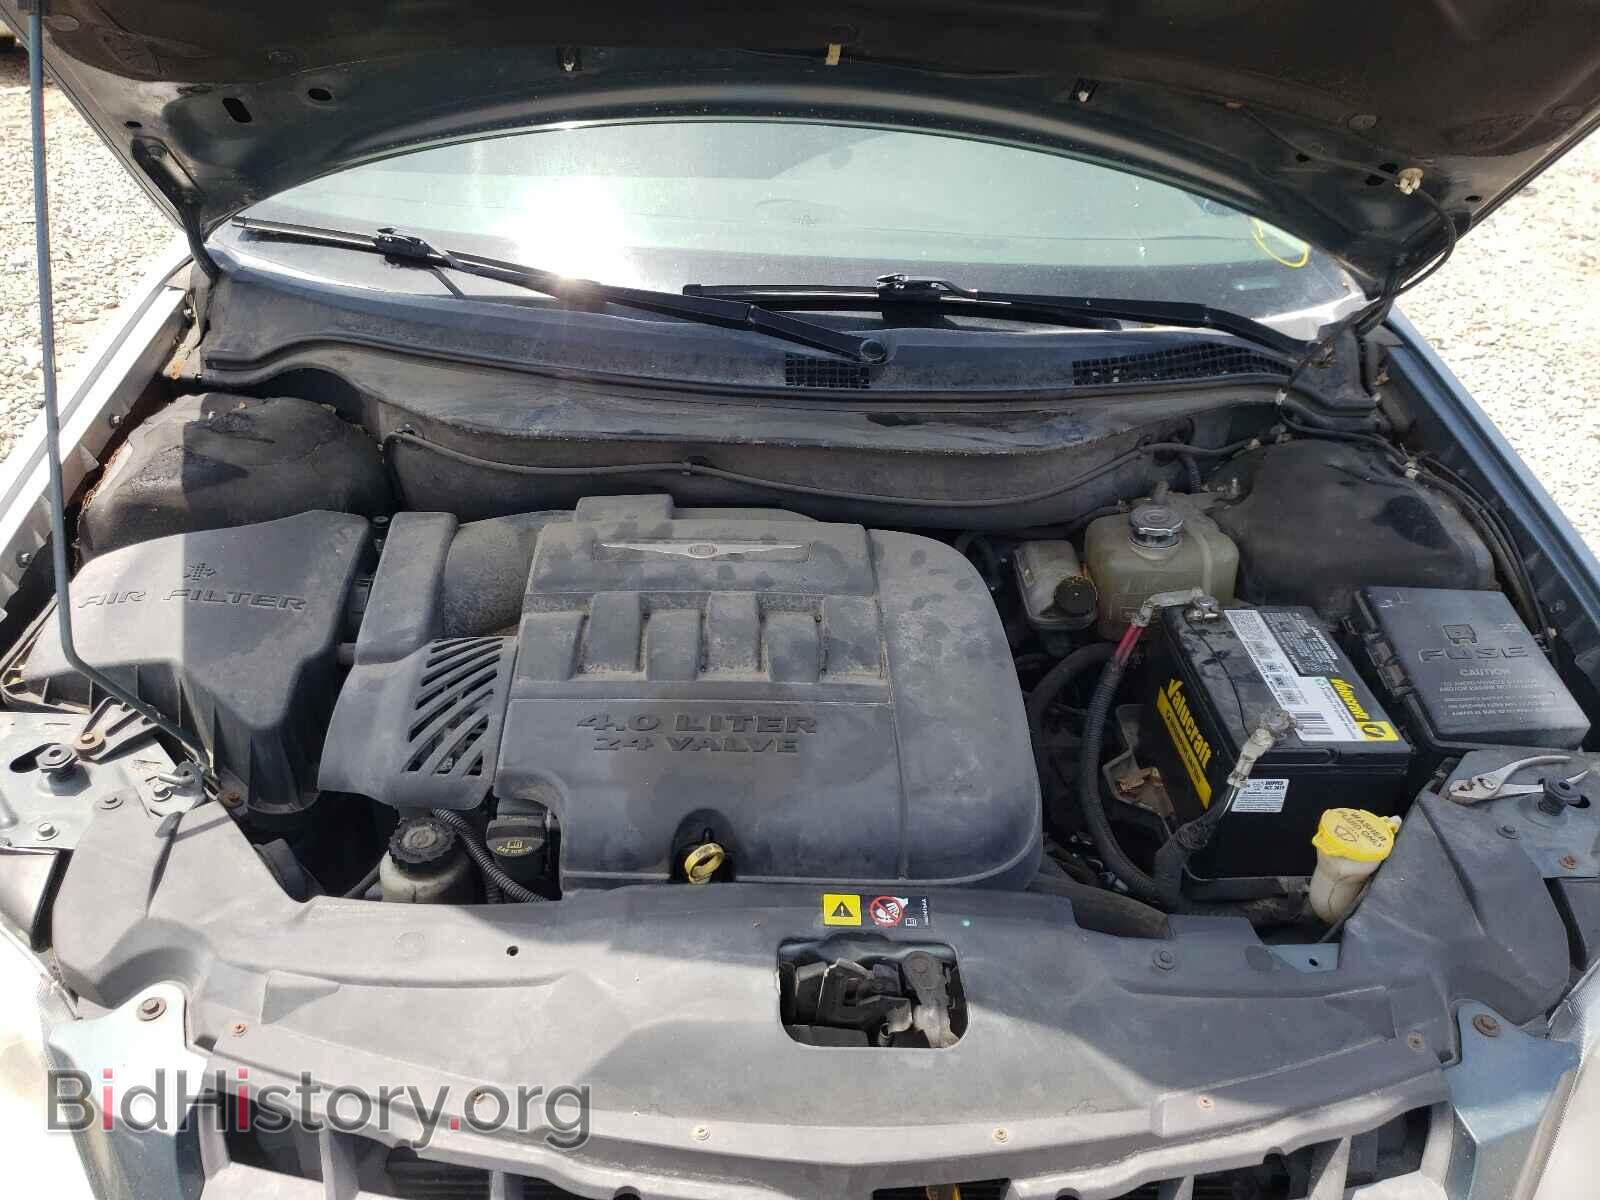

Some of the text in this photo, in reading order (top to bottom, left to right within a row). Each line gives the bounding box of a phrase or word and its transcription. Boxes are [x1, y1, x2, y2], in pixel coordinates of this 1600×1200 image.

[78, 589, 307, 611] AIR FILTER
[1418, 647, 1529, 662] FUSE
[577, 714, 817, 734] 4.0 LITER
[1167, 678, 1212, 769] Valucraft
[593, 737, 800, 753] 24 VALVE
